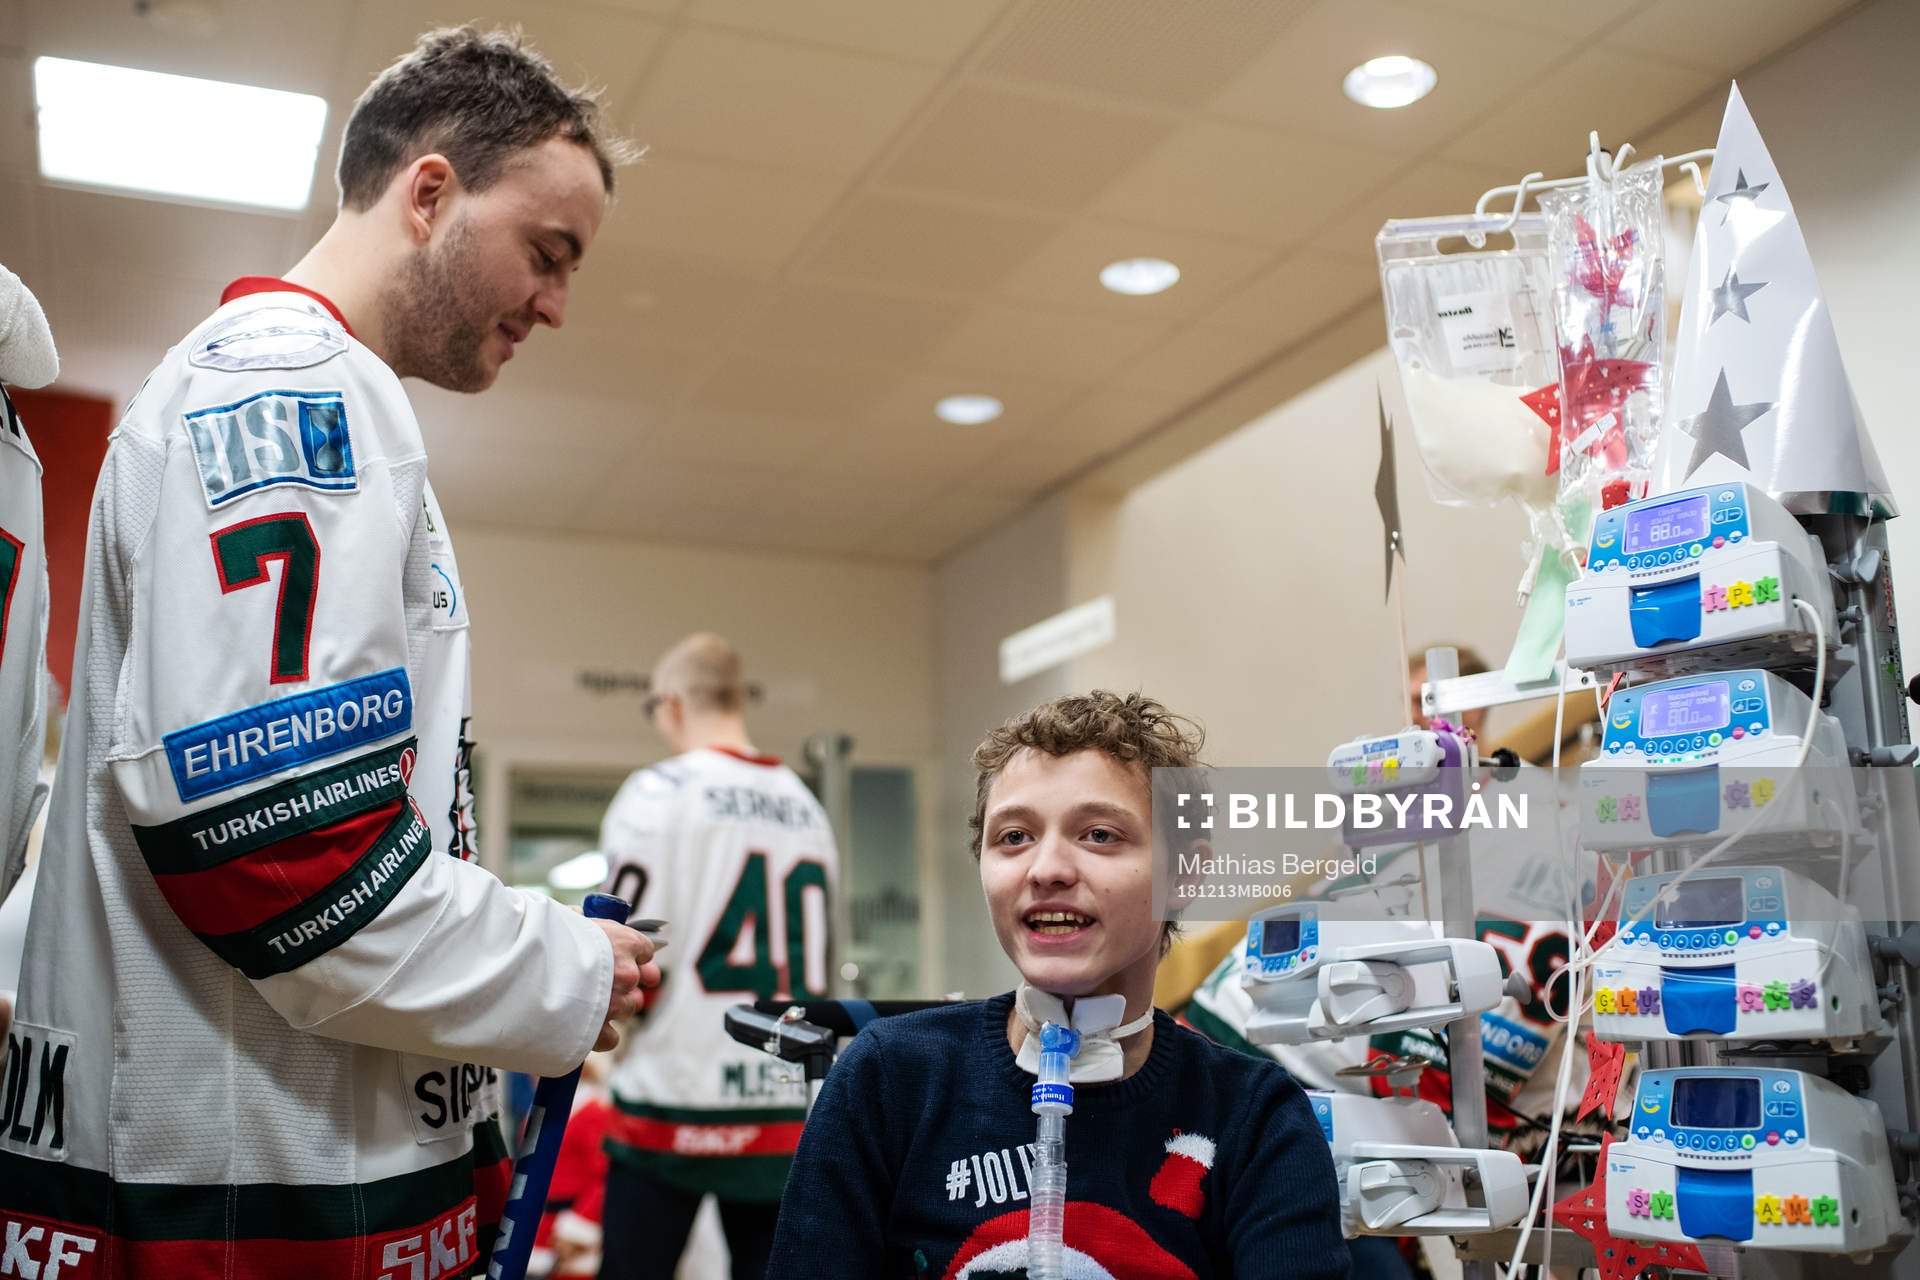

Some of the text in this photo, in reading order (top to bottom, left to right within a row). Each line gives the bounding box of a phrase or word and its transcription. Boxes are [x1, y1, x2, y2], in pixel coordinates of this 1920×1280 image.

[209, 511, 321, 685] 7
[433, 591, 448, 609] US
[1708, 583, 1770, 606] TPN
[184, 689, 403, 779] EHRENBORG
[1600, 784, 1769, 816] NA CL
[267, 881, 373, 955] TURKISH
[695, 848, 829, 1002] 40
[1599, 993, 1652, 1008] GLU
[1634, 1194, 1830, 1217] SV AMP
[382, 1203, 476, 1280] SKF
